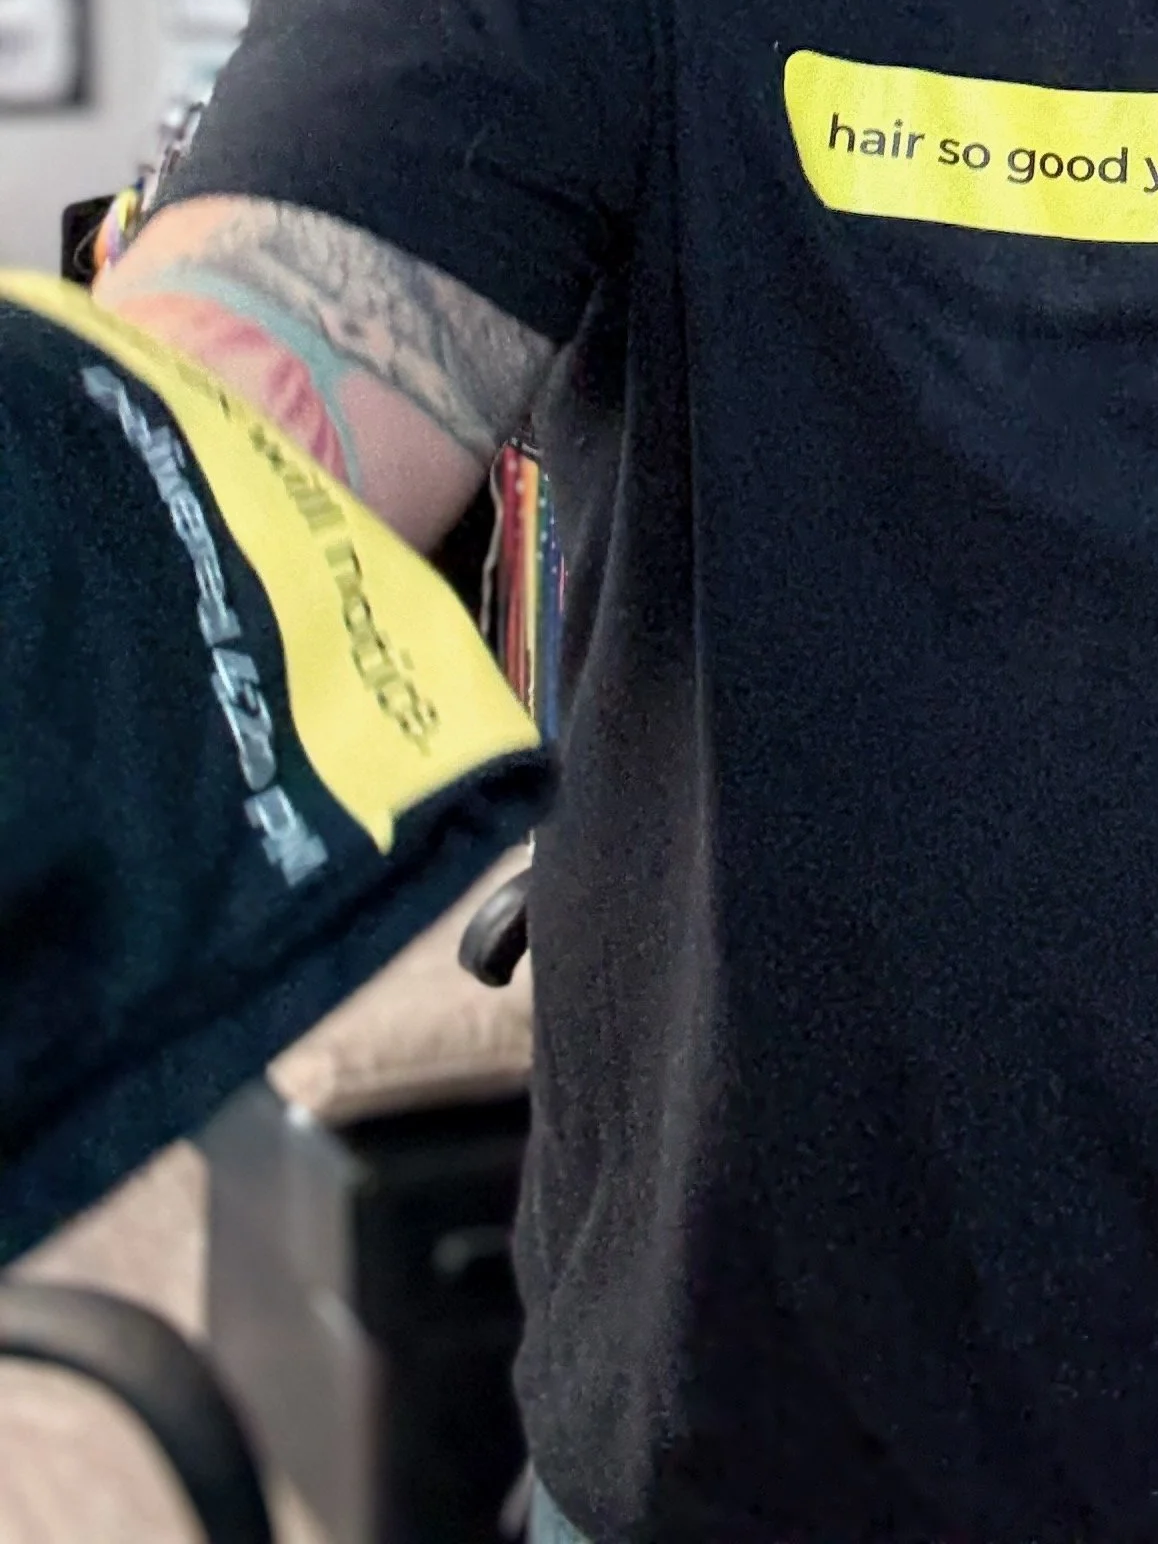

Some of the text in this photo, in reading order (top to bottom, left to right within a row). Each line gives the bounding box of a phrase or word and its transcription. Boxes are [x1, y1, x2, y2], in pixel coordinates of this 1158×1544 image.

[828, 112, 926, 159] hair
[937, 138, 991, 169] so
[1007, 146, 1129, 184] good
